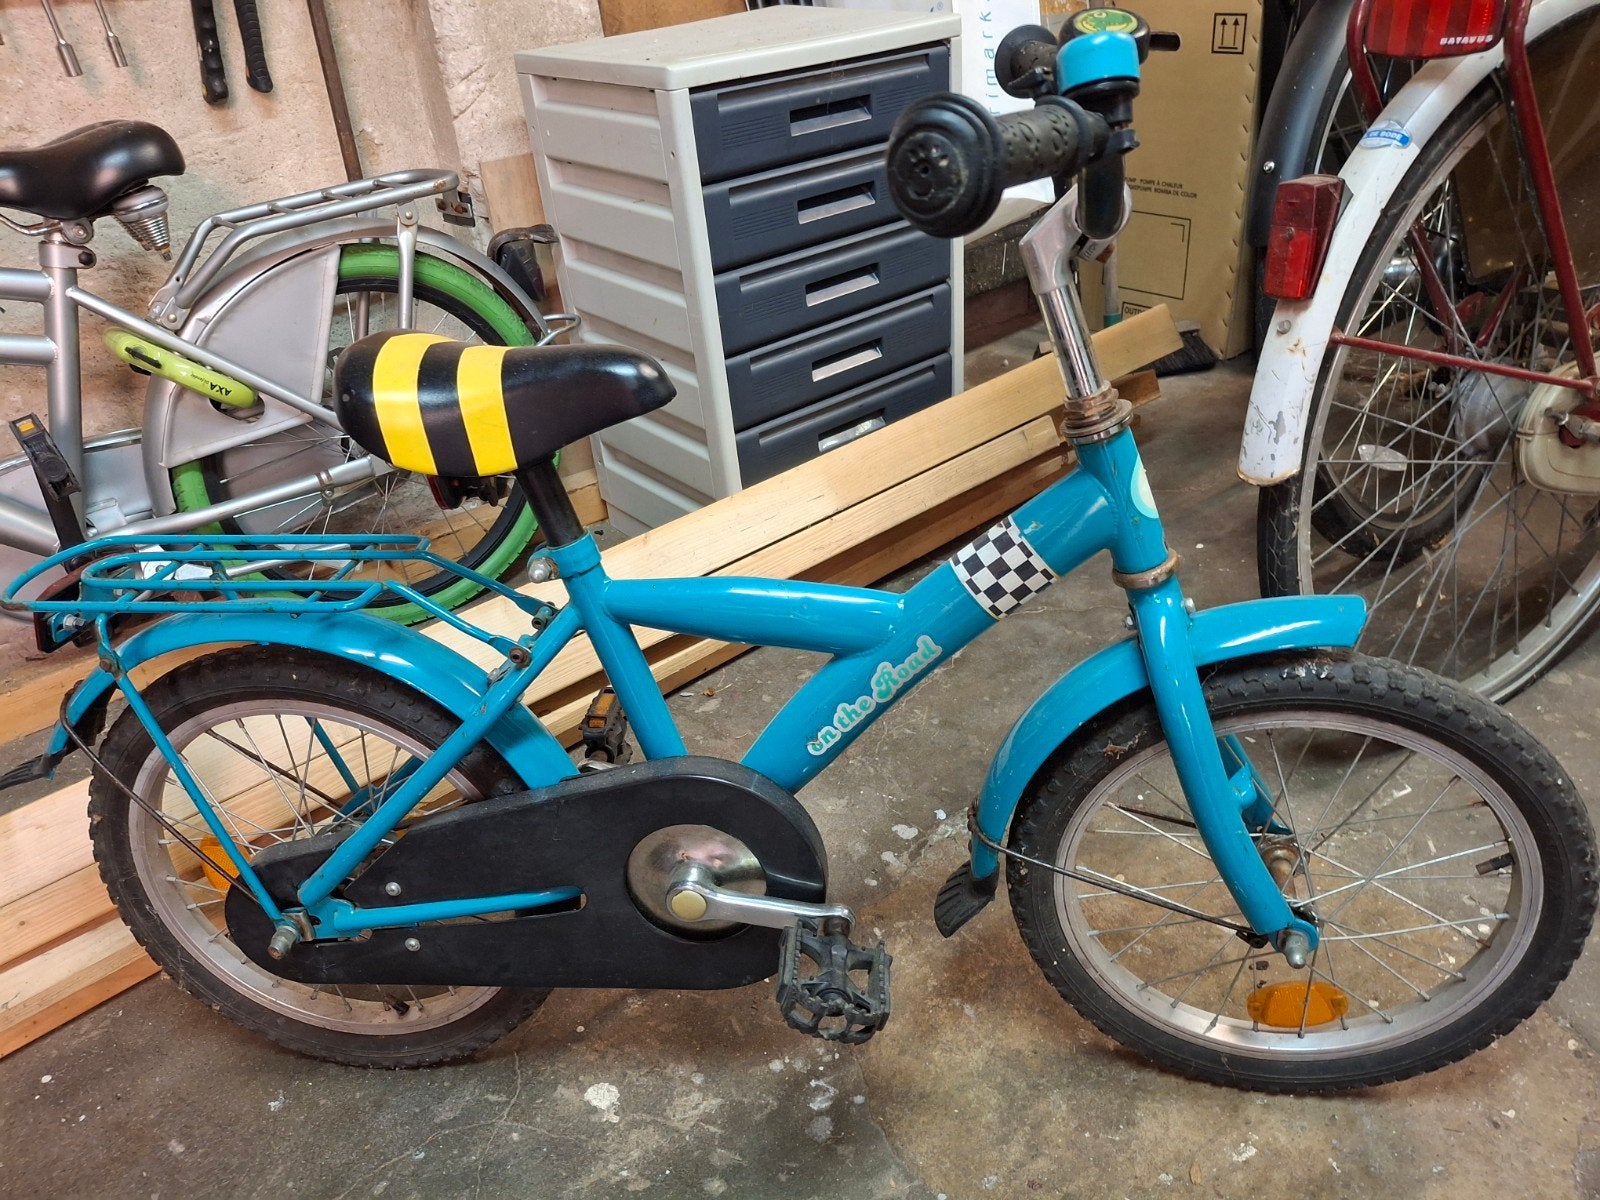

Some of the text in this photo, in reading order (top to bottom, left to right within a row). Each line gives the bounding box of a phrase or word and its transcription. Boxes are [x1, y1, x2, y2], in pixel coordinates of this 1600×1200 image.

[1440, 34, 1493, 45] BATAVUS
[210, 381, 232, 396] AXA
[836, 698, 873, 730] the
[873, 637, 939, 701] Road
